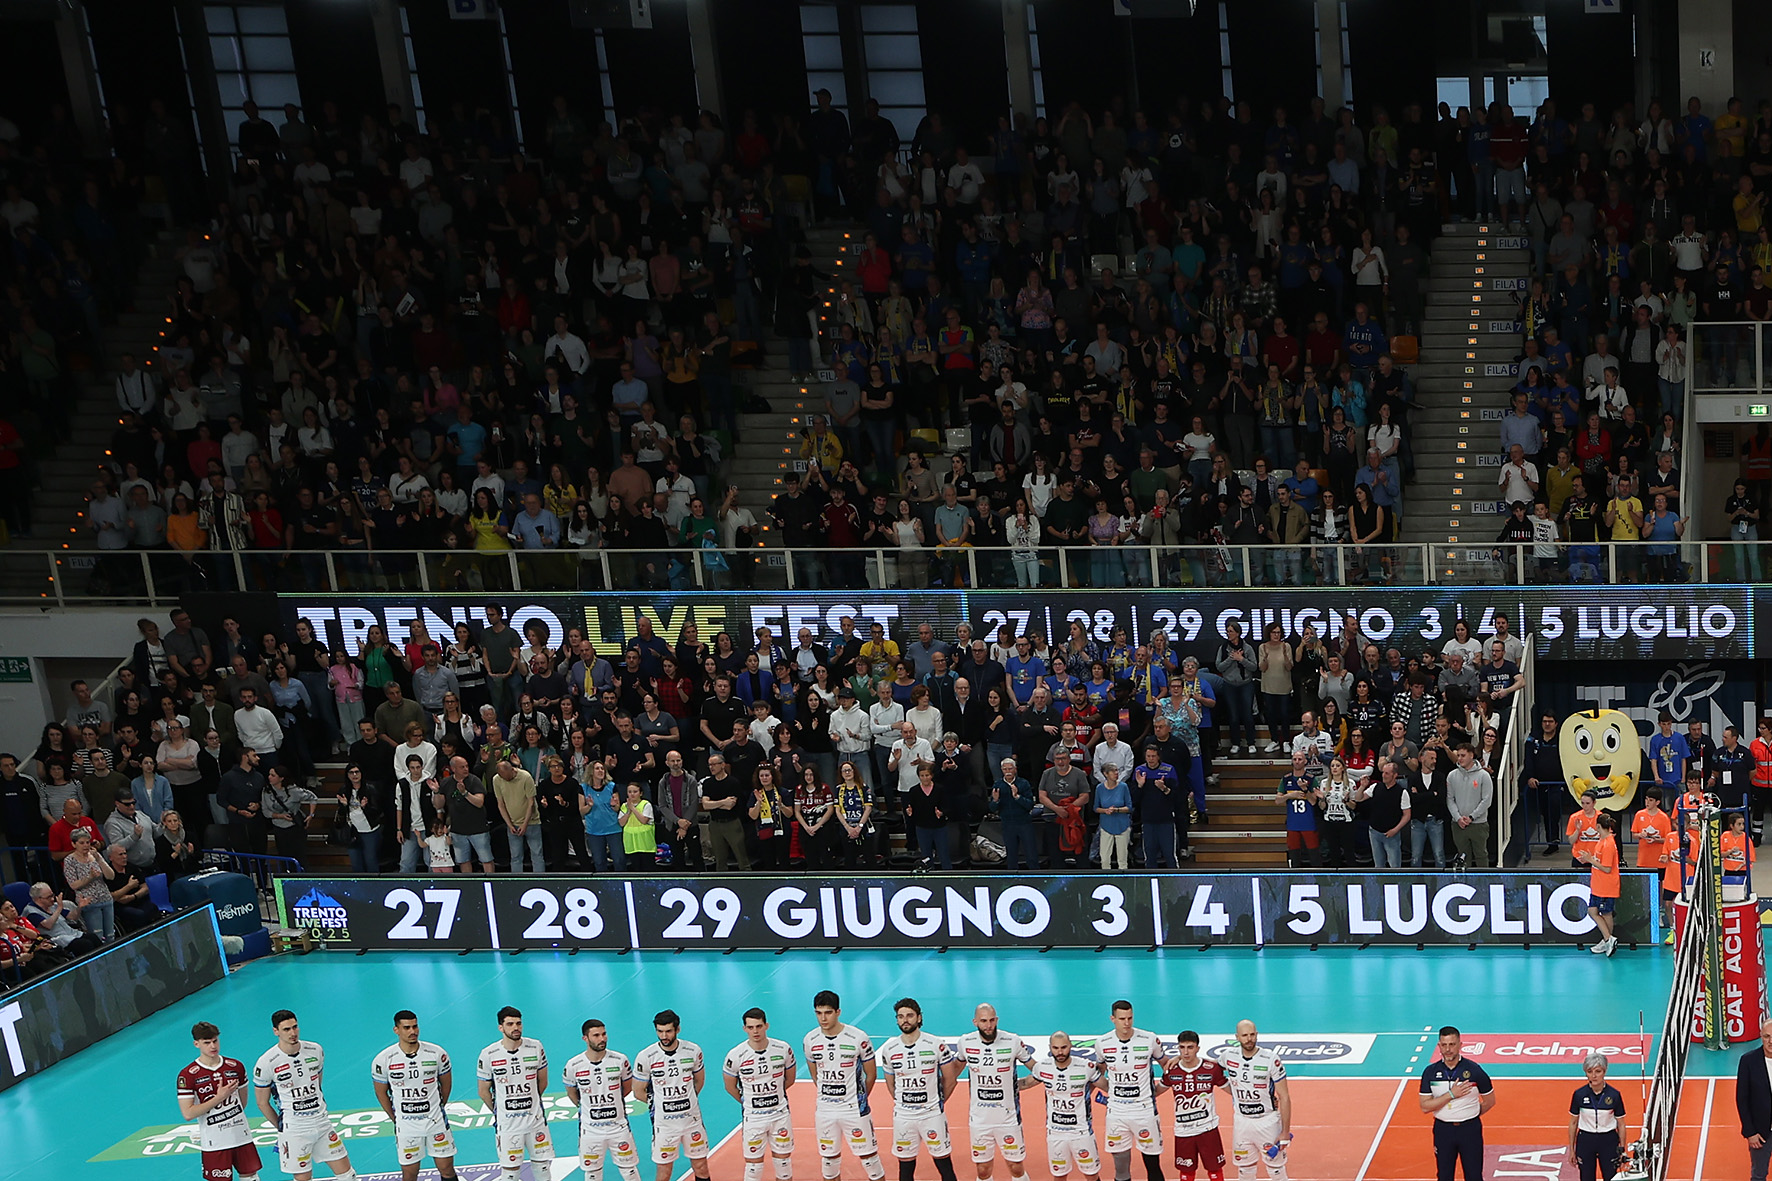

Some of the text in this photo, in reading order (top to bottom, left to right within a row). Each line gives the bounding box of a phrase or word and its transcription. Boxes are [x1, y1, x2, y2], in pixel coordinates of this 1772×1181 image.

[1499, 238, 1520, 249] FILA
[1495, 280, 1516, 290] FILA
[1491, 322, 1512, 332] FILA
[1487, 365, 1508, 375] FILA
[1473, 502, 1495, 513] FILA
[982, 610, 1031, 642] 27
[1152, 609, 1202, 641] 29
[1420, 607, 1442, 639] 3
[1541, 606, 1564, 639] 5
[1578, 604, 1737, 639] LUGLIO
[297, 604, 564, 658] TRENO
[1292, 800, 1306, 813] 13
[293, 907, 347, 918] TRENTO
[384, 883, 1596, 940] 27 28 29 GIUGNO 3 4 5 LUGLIO
[295, 918, 348, 928] LIVE FEST
[1724, 910, 1745, 1037] CAF ACLI
[1494, 1039, 1651, 1058] dalmec
[828, 1051, 835, 1061] 8
[983, 1056, 995, 1067] 22
[1122, 1054, 1128, 1064] 4
[511, 1065, 522, 1075] 15
[758, 1065, 769, 1076] 12
[907, 1060, 917, 1070] 11
[296, 1067, 303, 1078] 5
[408, 1069, 420, 1080] 10
[668, 1067, 680, 1078] 23
[822, 1070, 845, 1081] ITAS
[1242, 1071, 1248, 1081] 6
[596, 1075, 603, 1085] 3
[901, 1077, 926, 1089] ITAS
[977, 1074, 1003, 1086] ITAS
[291, 1084, 316, 1099] ITAS
[401, 1086, 428, 1099] ITAS
[505, 1082, 531, 1095] ITAS
[662, 1084, 688, 1097] ITAS
[752, 1081, 778, 1093] ITAS
[1056, 1082, 1068, 1092] 25
[1185, 1082, 1195, 1093] 13
[588, 1092, 615, 1105] ITAS
